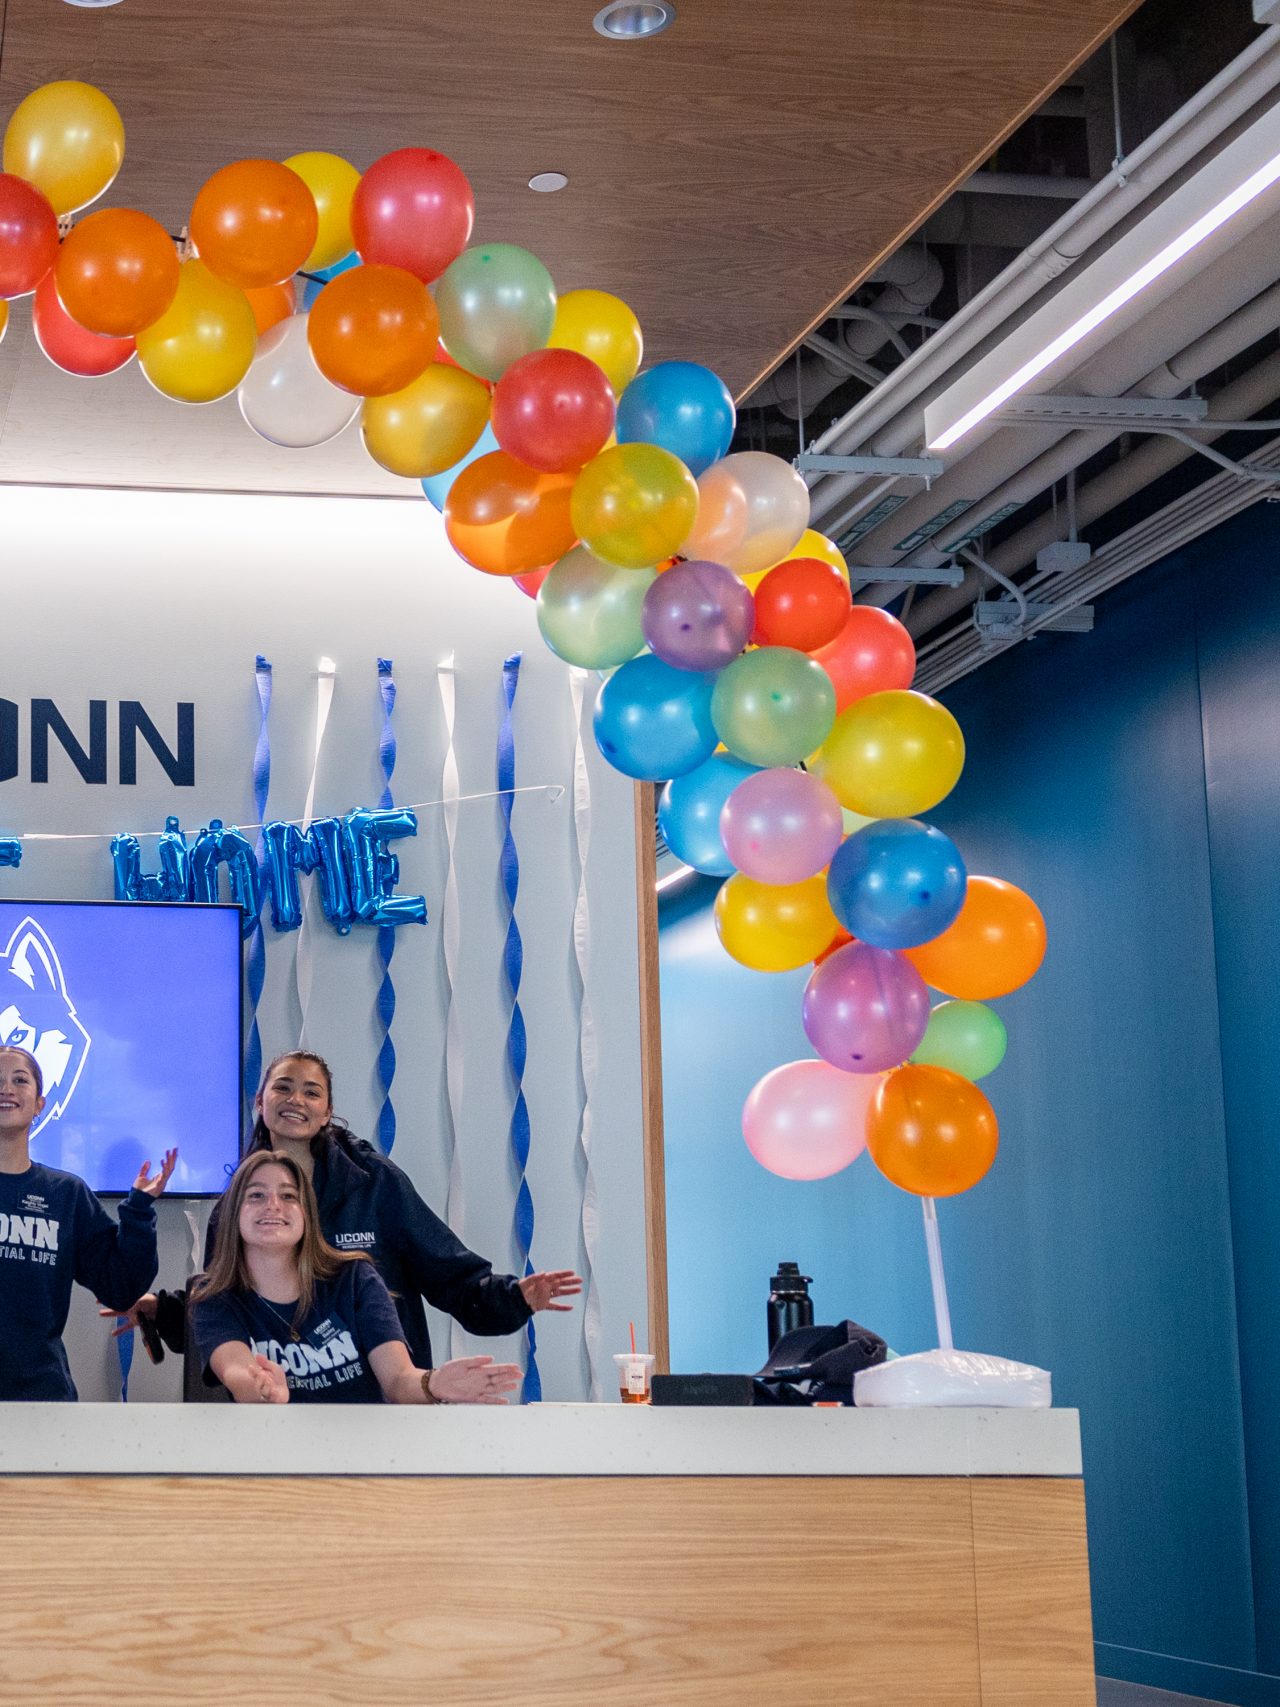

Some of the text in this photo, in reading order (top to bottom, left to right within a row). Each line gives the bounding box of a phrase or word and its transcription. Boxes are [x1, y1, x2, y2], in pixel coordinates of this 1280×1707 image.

[335, 1231, 376, 1243] UCONN
[31, 1249, 58, 1266] LIFE
[335, 1362, 363, 1383] LIFE
